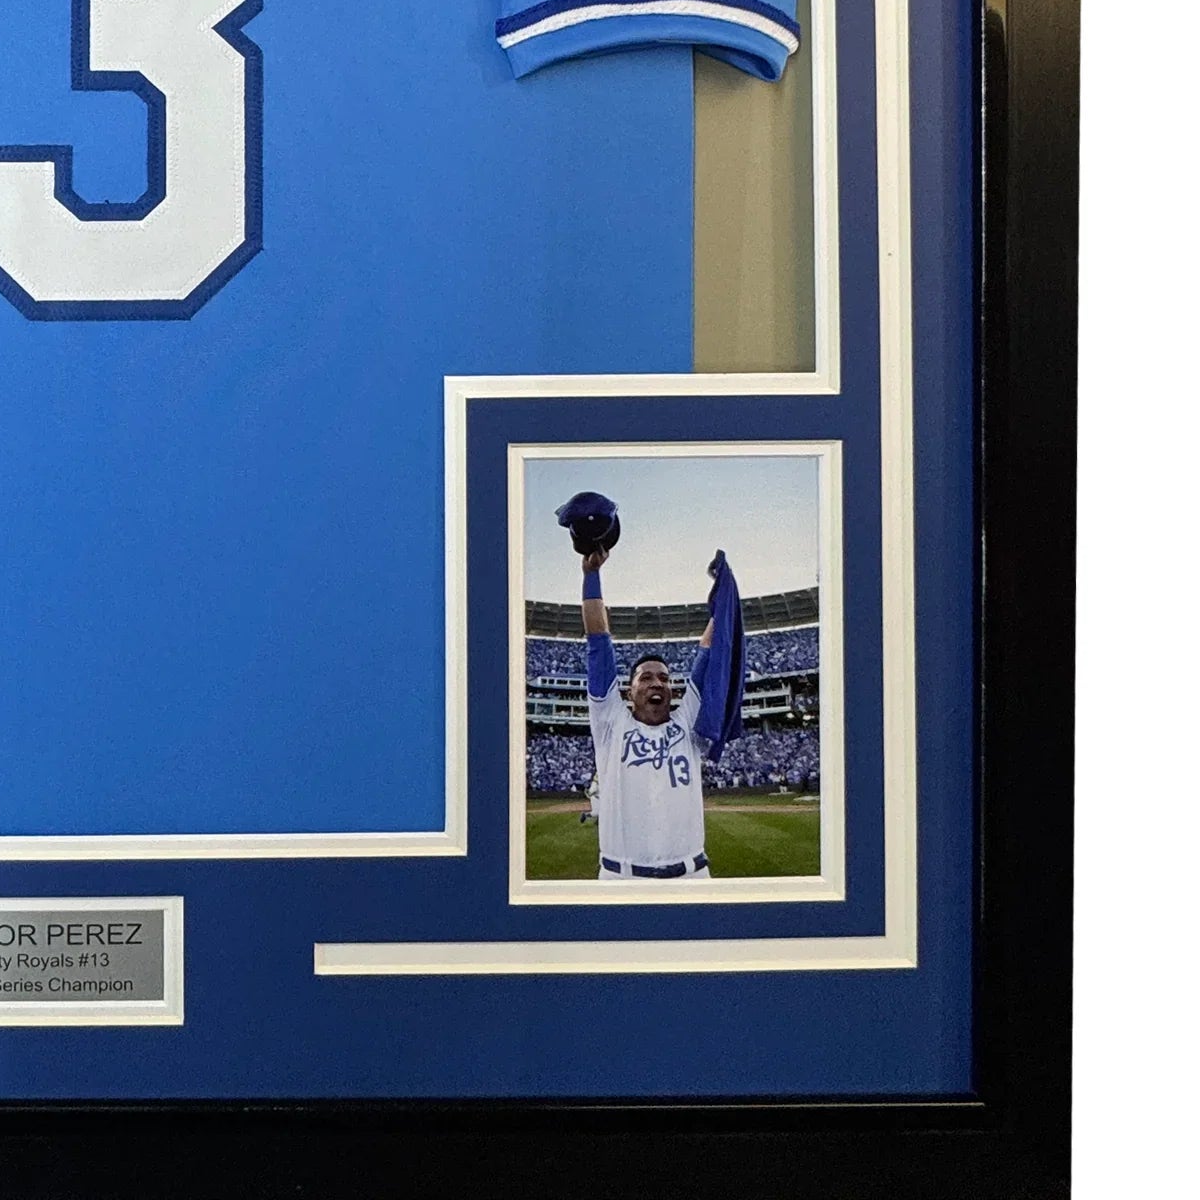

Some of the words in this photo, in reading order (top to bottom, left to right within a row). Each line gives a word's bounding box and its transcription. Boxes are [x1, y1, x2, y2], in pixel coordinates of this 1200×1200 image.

[667, 755, 690, 788] 13
[47, 923, 143, 946] PEREZ
[17, 953, 74, 972] Royals
[78, 952, 110, 968] #13
[48, 977, 134, 995] Champion
